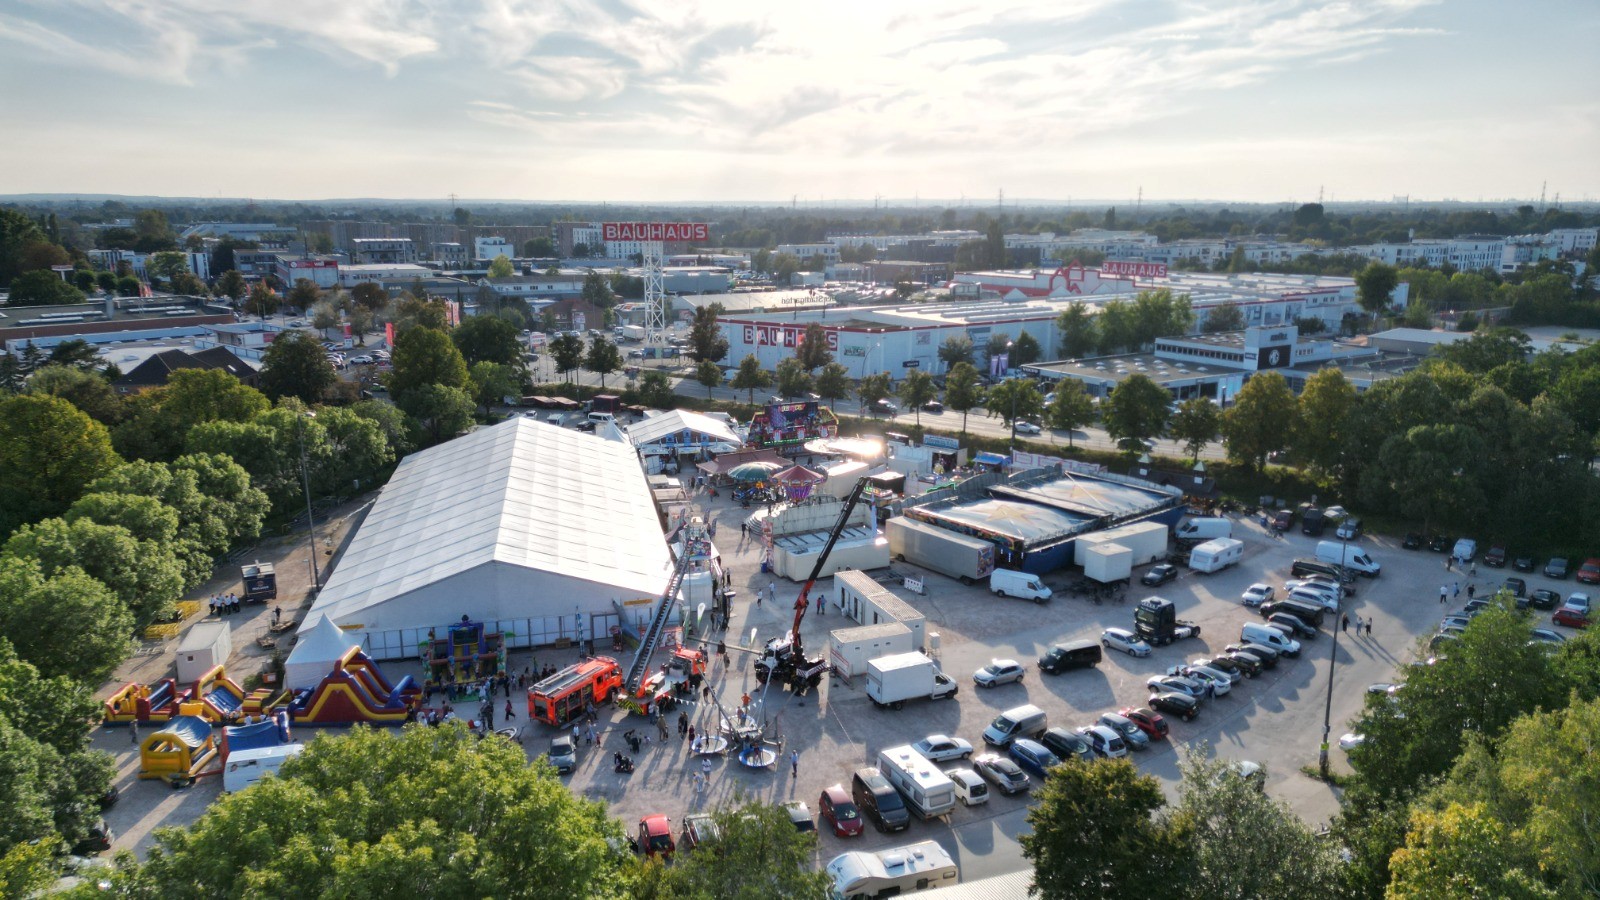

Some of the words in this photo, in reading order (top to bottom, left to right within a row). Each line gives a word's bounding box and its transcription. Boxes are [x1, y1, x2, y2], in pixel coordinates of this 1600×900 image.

[606, 225, 706, 239] BAUHAUS
[1103, 263, 1165, 276] BAUHAUS
[745, 327, 836, 349] BAUHS
